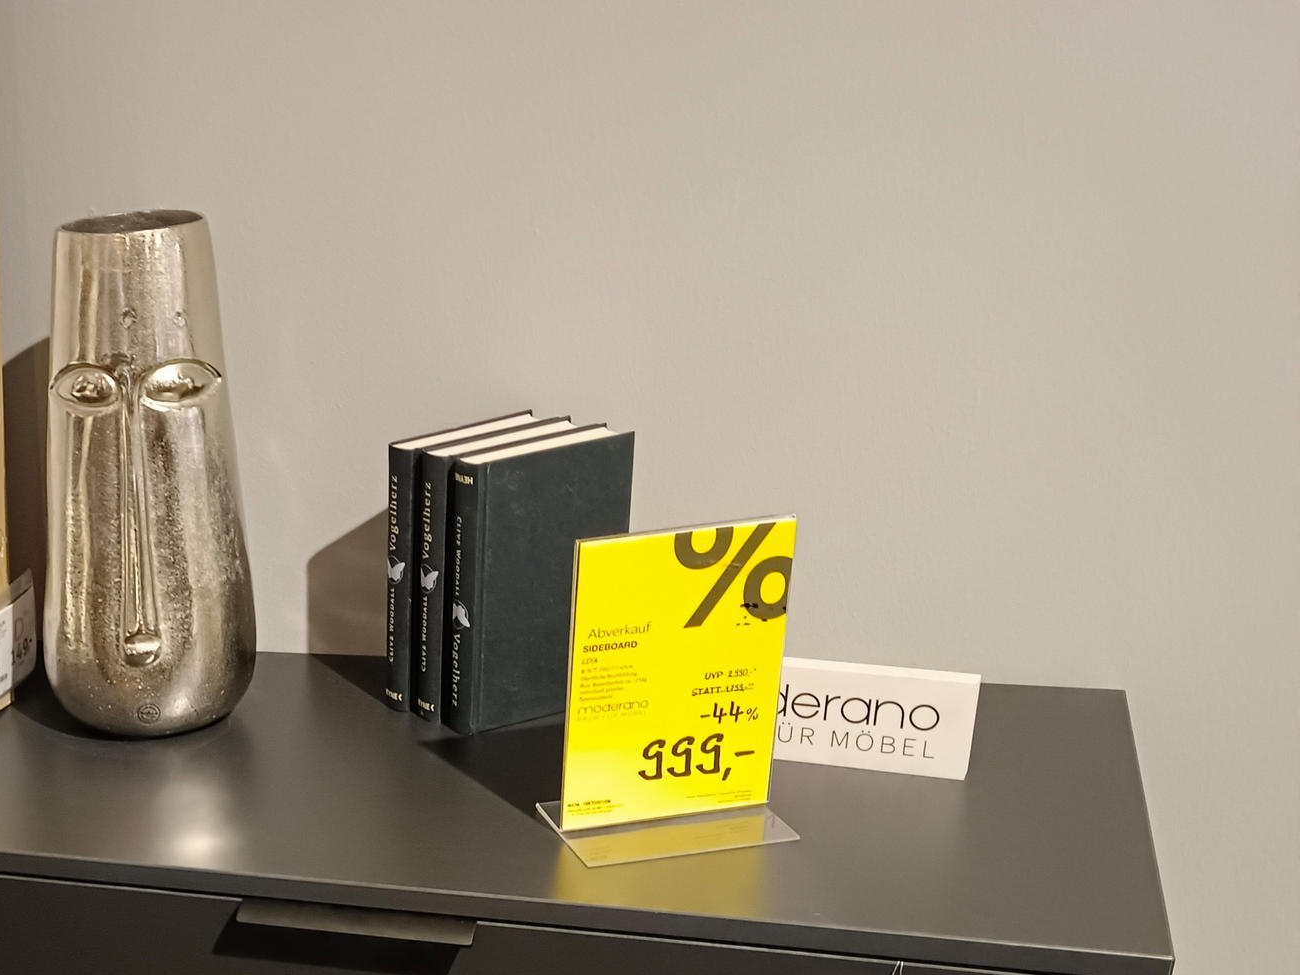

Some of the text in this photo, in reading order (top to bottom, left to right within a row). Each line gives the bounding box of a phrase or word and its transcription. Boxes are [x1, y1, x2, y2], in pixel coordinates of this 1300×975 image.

[388, 475, 399, 551] Vogelherz
[421, 482, 432, 559] Vogelherz
[587, 621, 651, 639] Abverkauf
[582, 641, 638, 653] SIDEBOARD
[452, 633, 461, 707] Vogelherz
[704, 671, 724, 680] UVP
[692, 686, 721, 696] STATT
[578, 700, 649, 715] moderano
[778, 684, 940, 731] derano
[778, 722, 935, 759] ÜR MÖBEL
